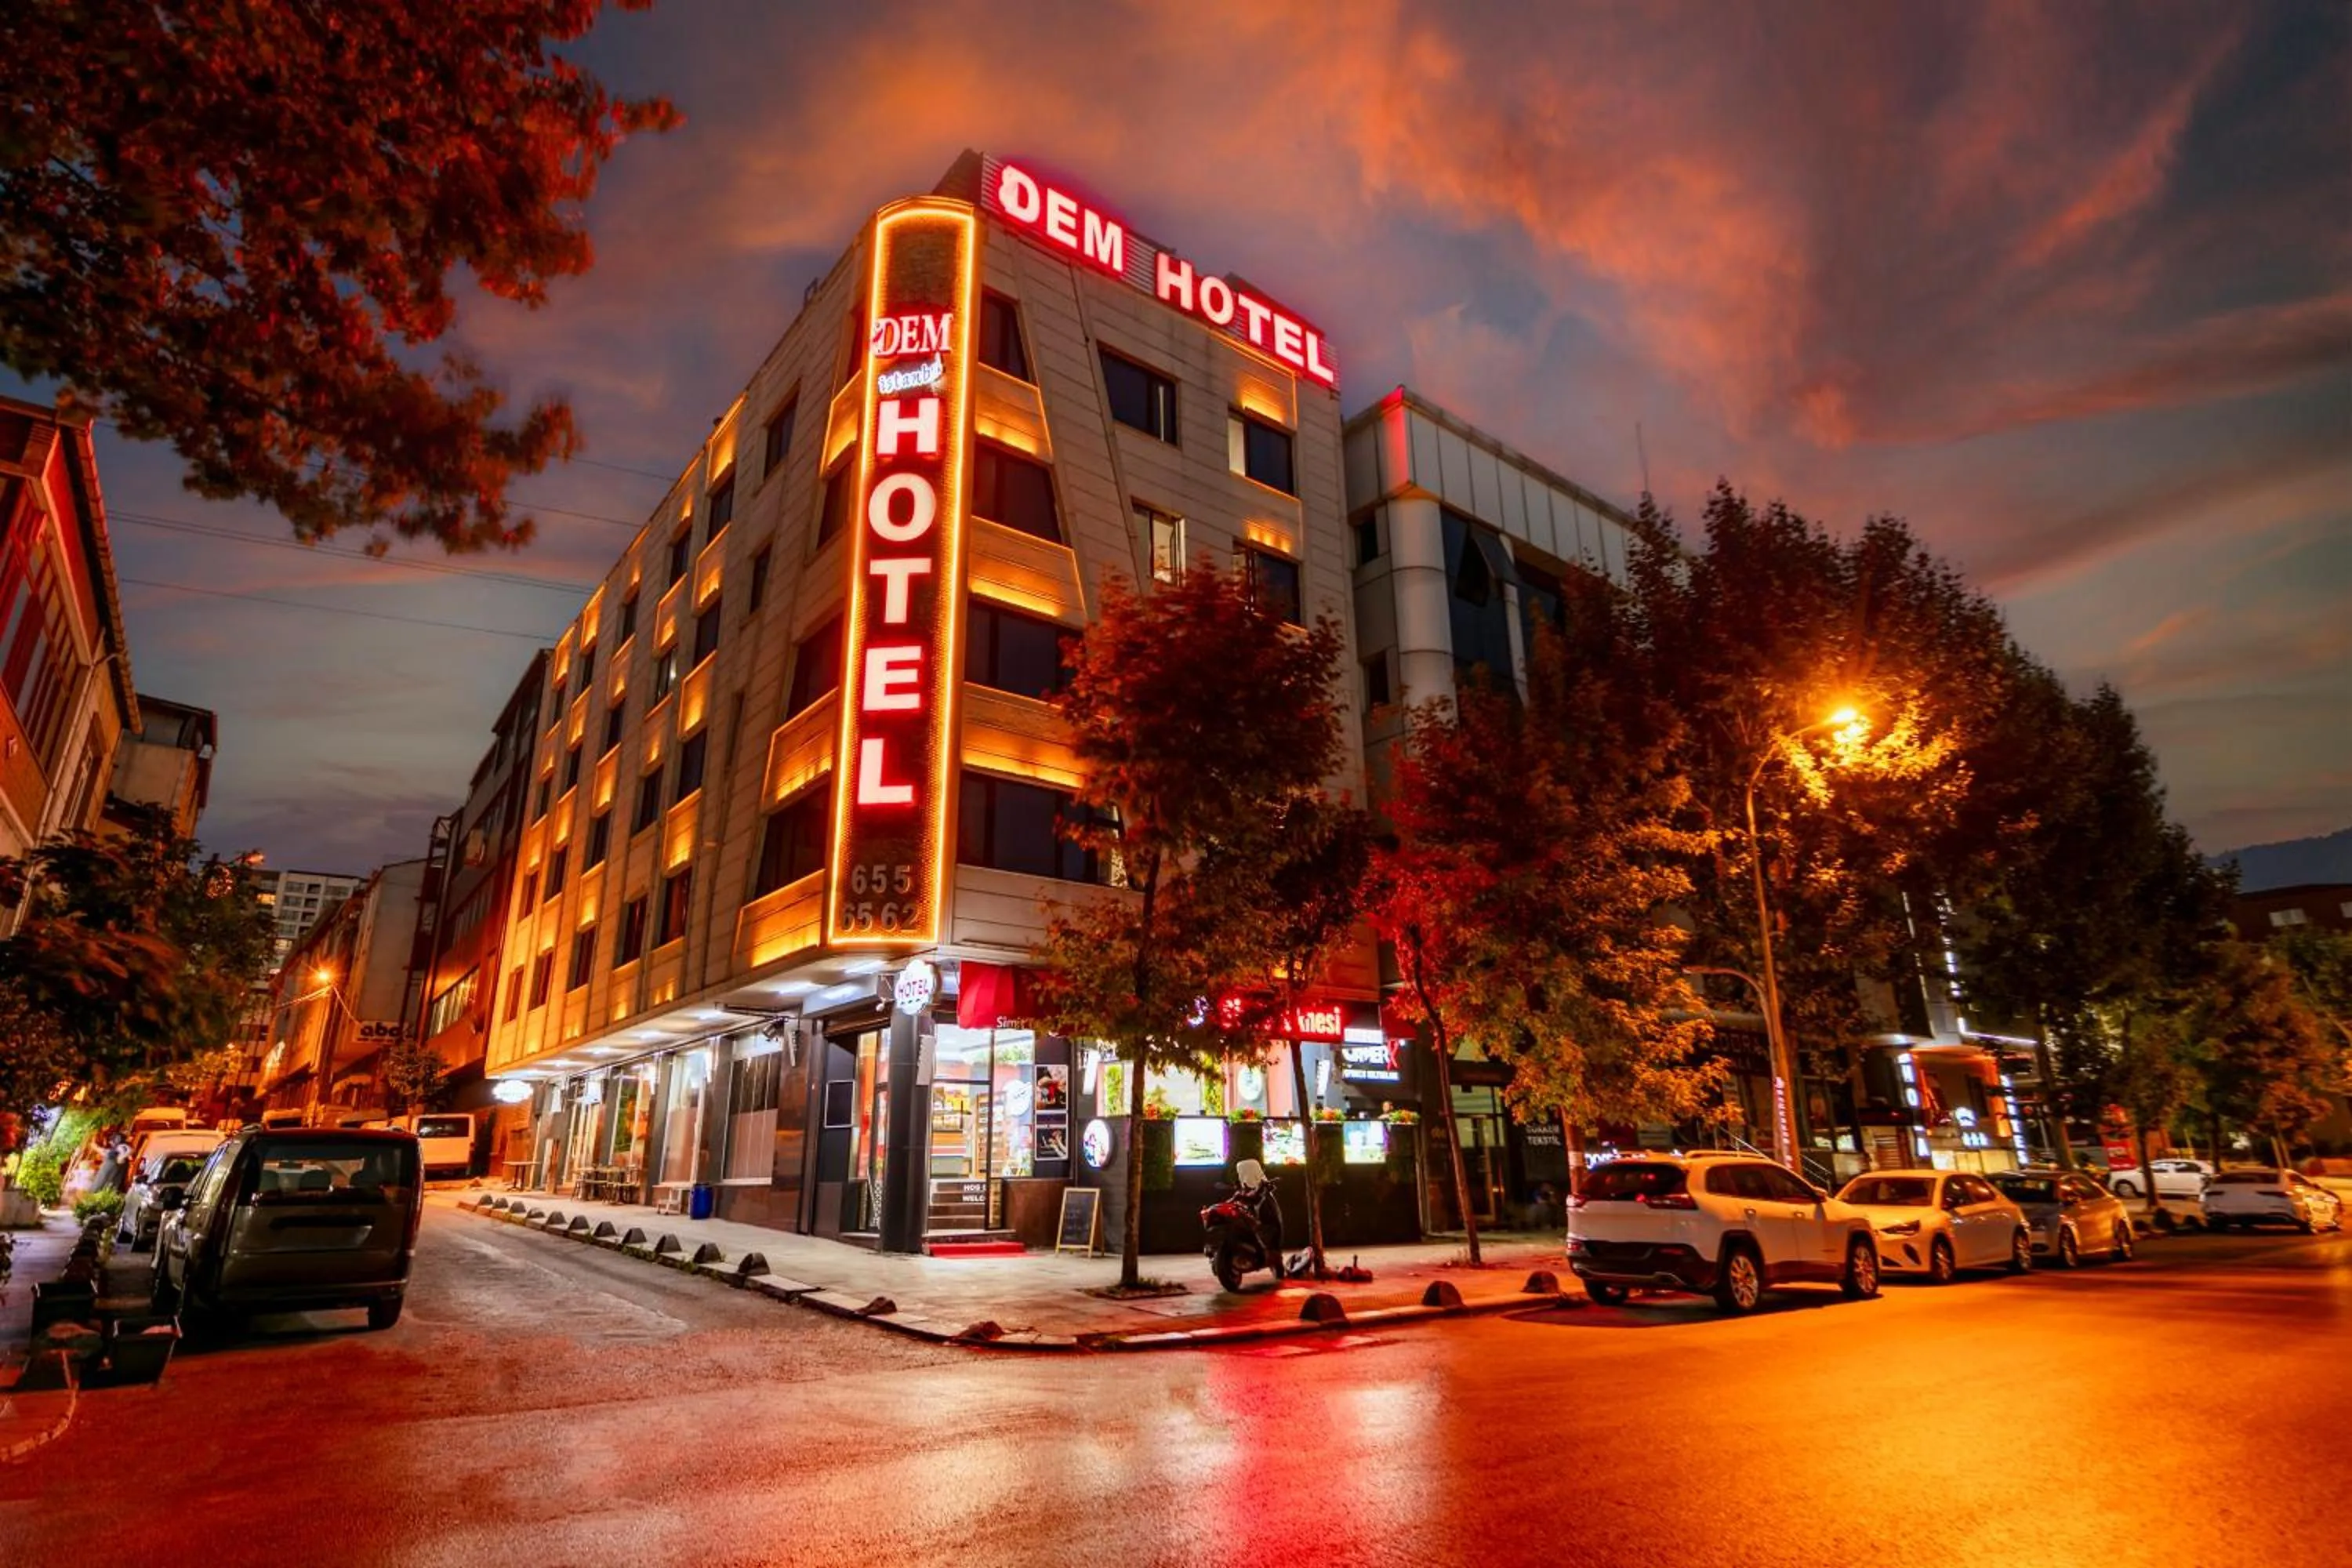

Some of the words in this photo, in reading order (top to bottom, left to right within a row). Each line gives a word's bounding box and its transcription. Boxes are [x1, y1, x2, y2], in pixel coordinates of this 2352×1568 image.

[999, 165, 1123, 272] DEM
[1156, 251, 1334, 384] HOTEL
[870, 313, 953, 356] DEM
[858, 397, 940, 805] HOTEL
[851, 864, 910, 894] 655
[898, 978, 929, 1000] HOTEL
